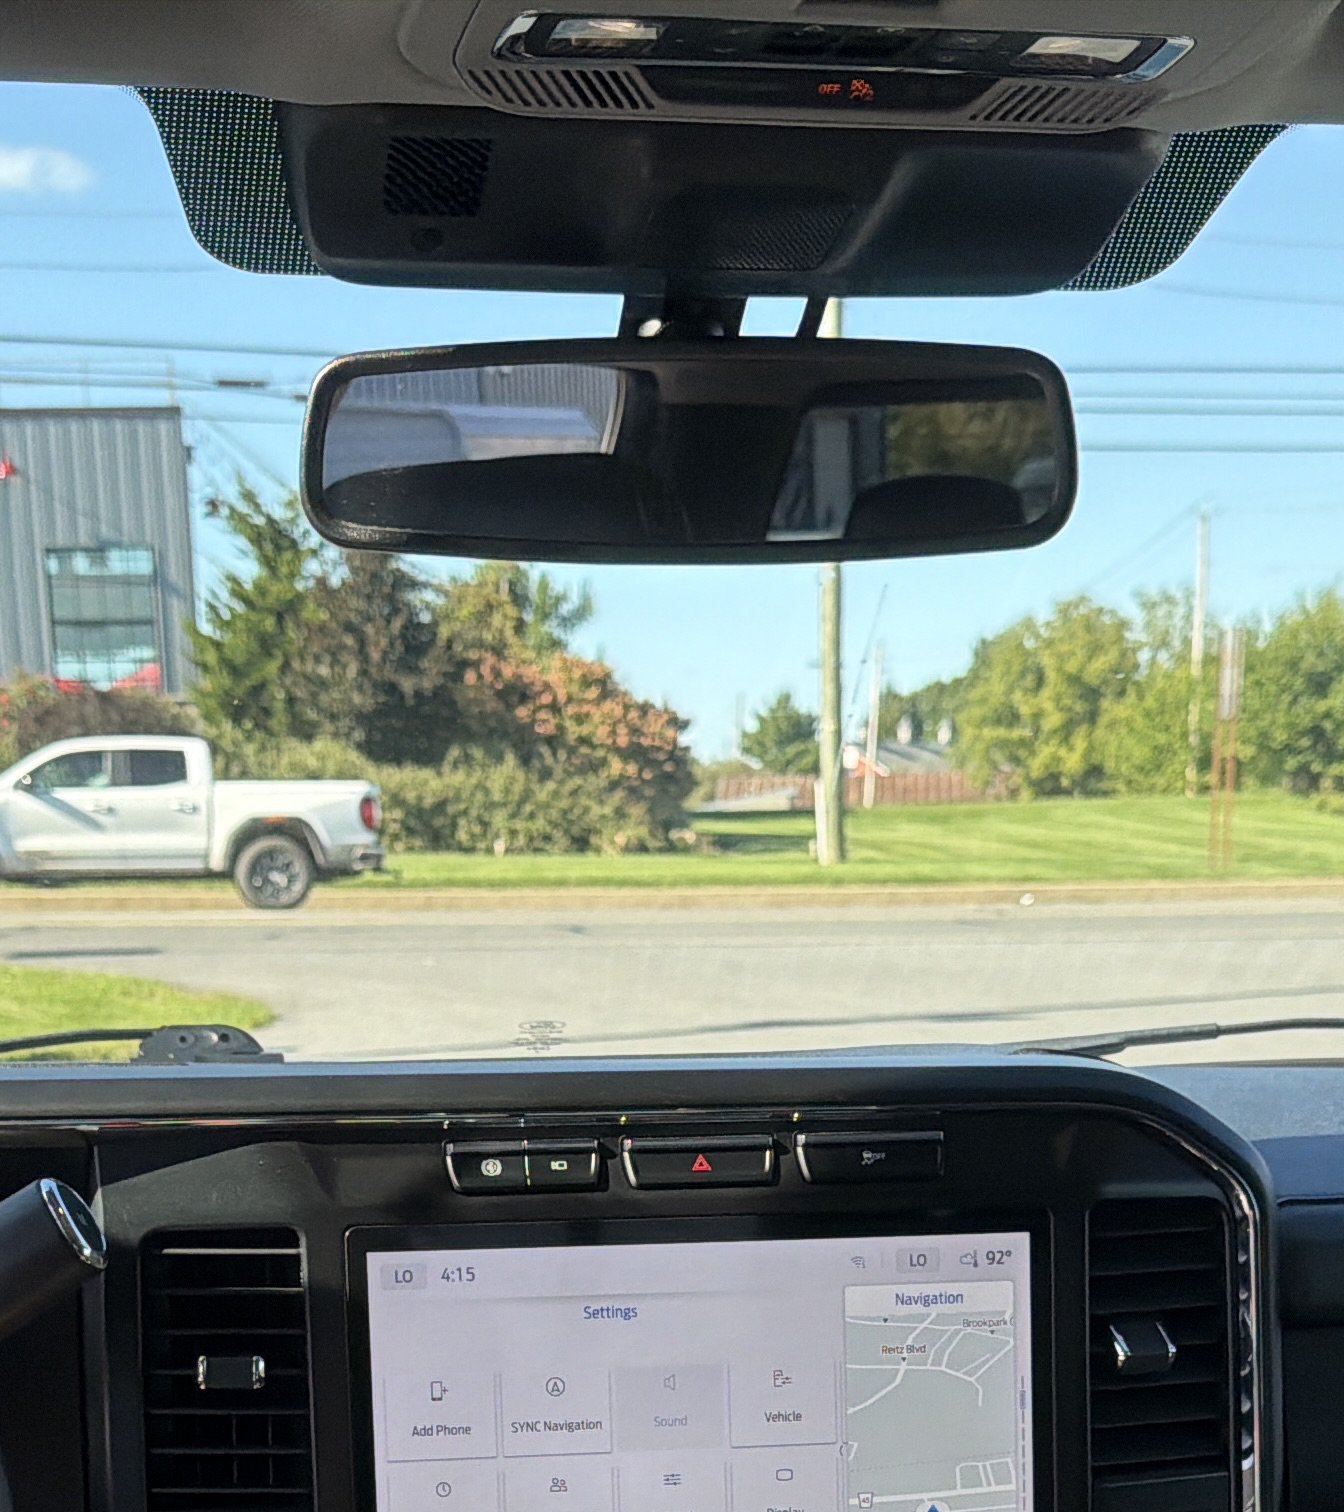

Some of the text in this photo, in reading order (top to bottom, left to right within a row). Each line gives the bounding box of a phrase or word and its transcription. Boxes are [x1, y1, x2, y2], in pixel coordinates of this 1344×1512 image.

[817, 83, 842, 95] OFF
[909, 1253, 927, 1268] LO
[394, 1265, 476, 1285] LO 4:15
[895, 1292, 964, 1308] Navigation
[583, 1303, 639, 1323] Settings
[962, 1318, 1008, 1328] Brookpark
[906, 1344, 927, 1354] Blvd
[654, 1413, 689, 1429] Sound
[764, 1409, 803, 1425] Vehicle
[411, 1420, 472, 1438] Add Phone
[511, 1416, 603, 1435] SYNC Navigation
